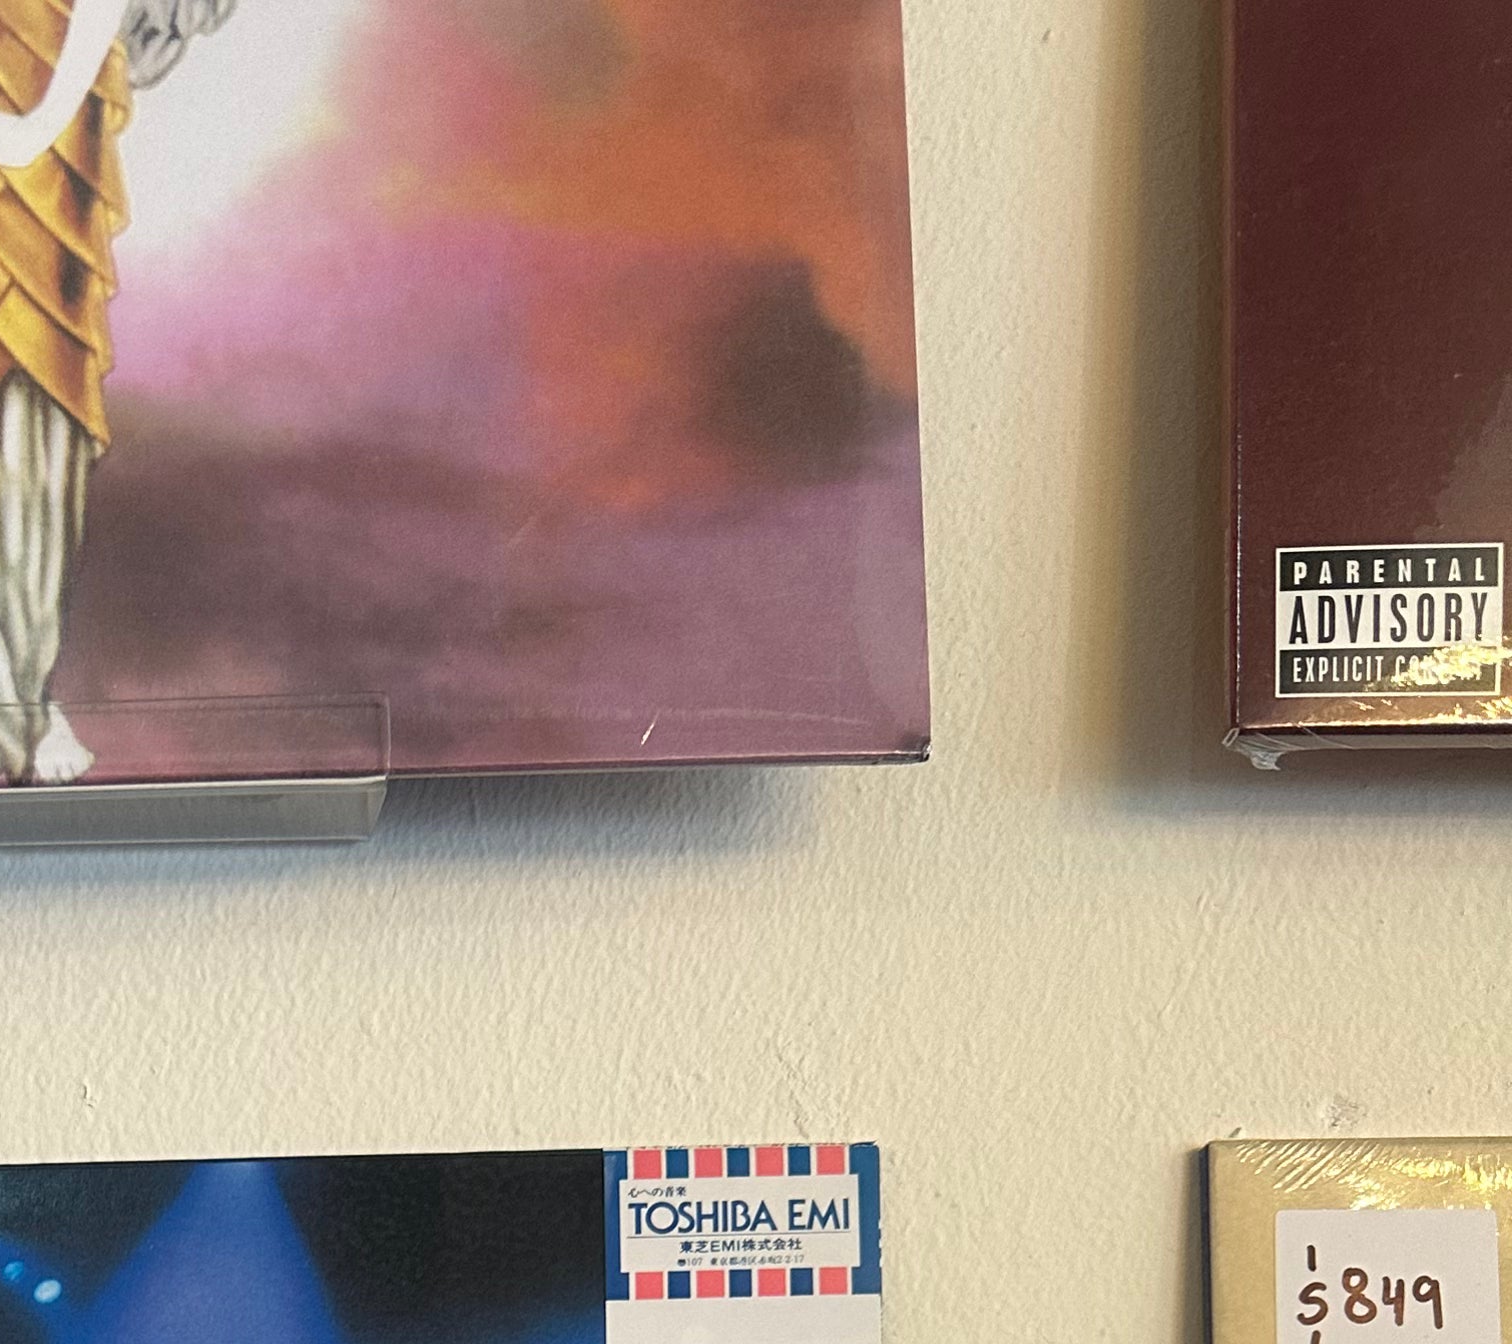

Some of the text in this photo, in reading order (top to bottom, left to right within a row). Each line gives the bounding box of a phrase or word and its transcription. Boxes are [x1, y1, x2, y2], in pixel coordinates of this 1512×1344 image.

[1294, 557, 1485, 585] PARENTAL
[1288, 592, 1488, 645] ADVISORY
[1293, 655, 1384, 682] EXPLICIT
[628, 1198, 849, 1235] TOSHIBA EMI
[679, 1238, 802, 1254] 東芝EMI株式会社
